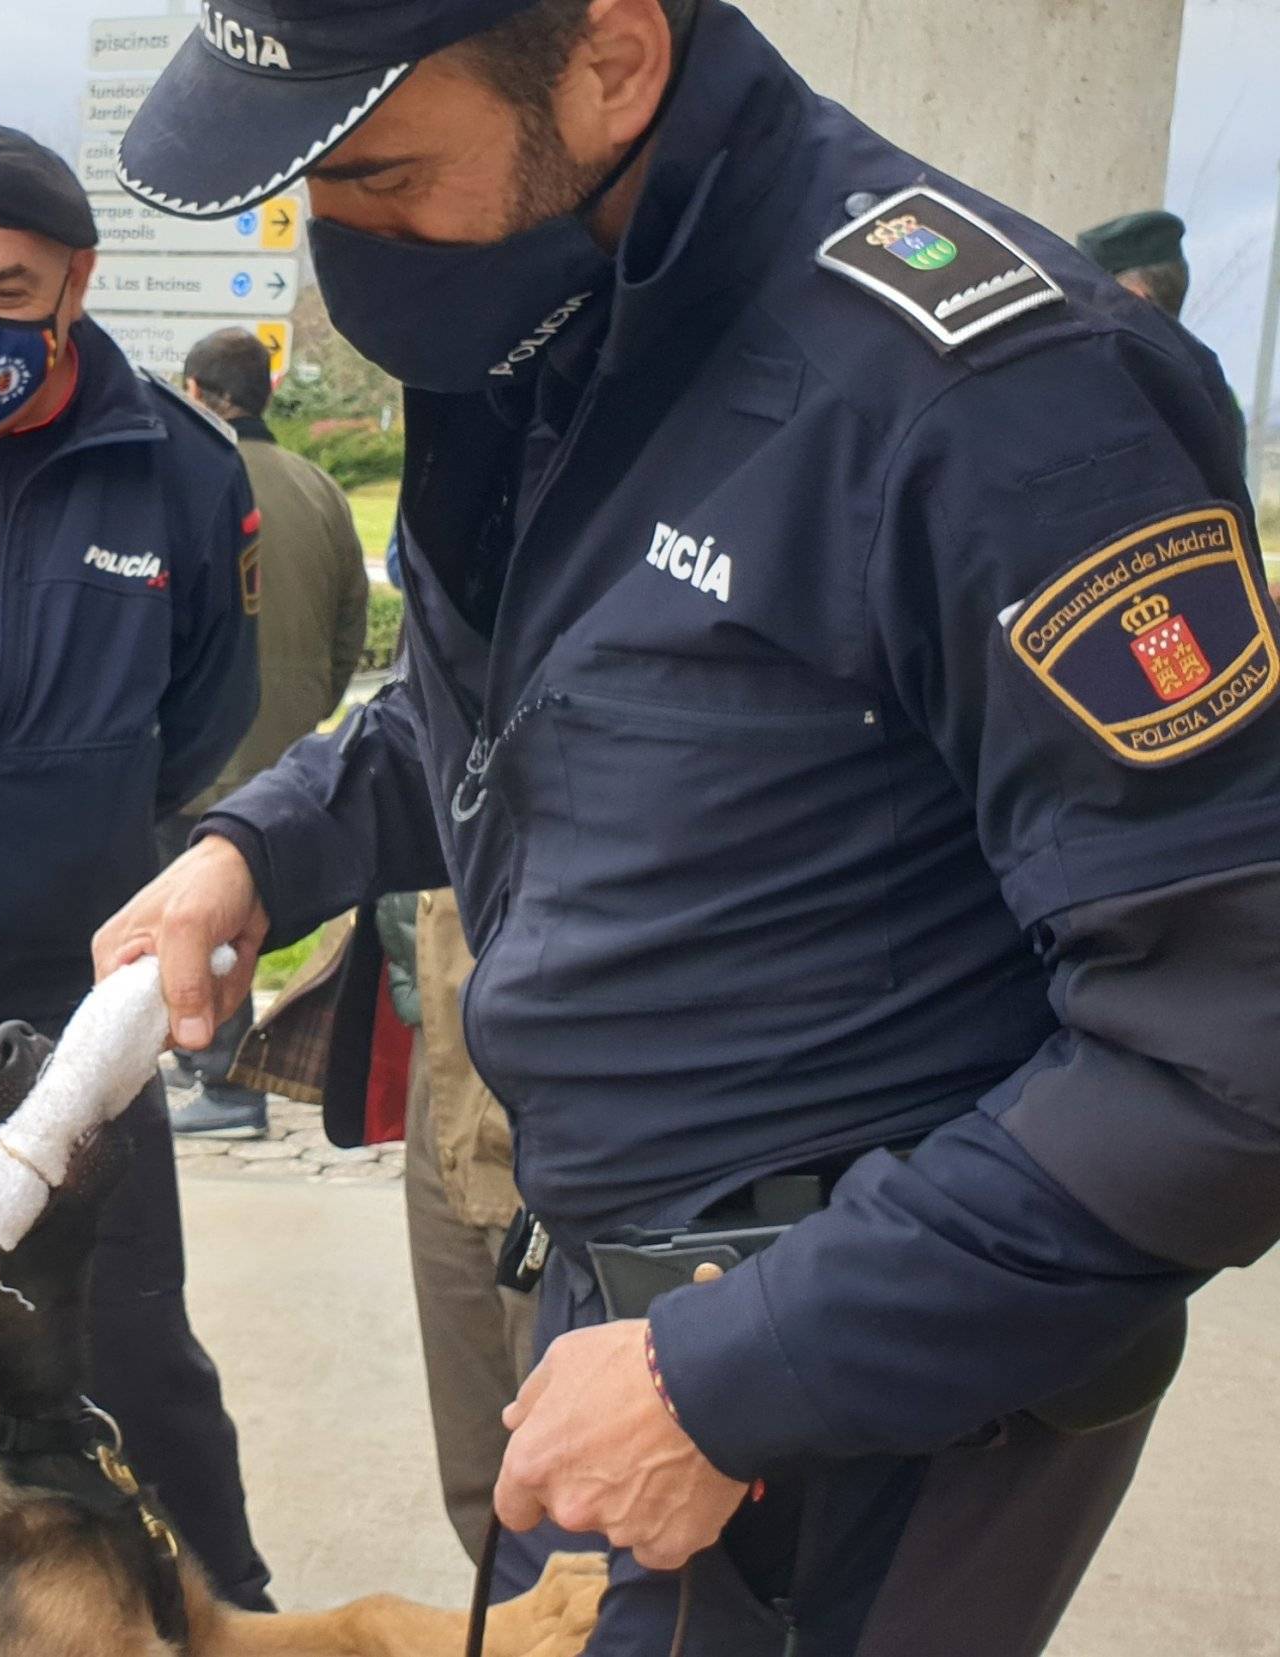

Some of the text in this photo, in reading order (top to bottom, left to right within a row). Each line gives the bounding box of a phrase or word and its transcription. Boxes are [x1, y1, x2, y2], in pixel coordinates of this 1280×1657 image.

[94, 32, 169, 58] piscinas
[200, 1, 292, 70] LICIA
[90, 206, 134, 225] arque
[1027, 525, 1226, 653] Comunidad de Madrid
[1208, 664, 1268, 716] LOCAL
